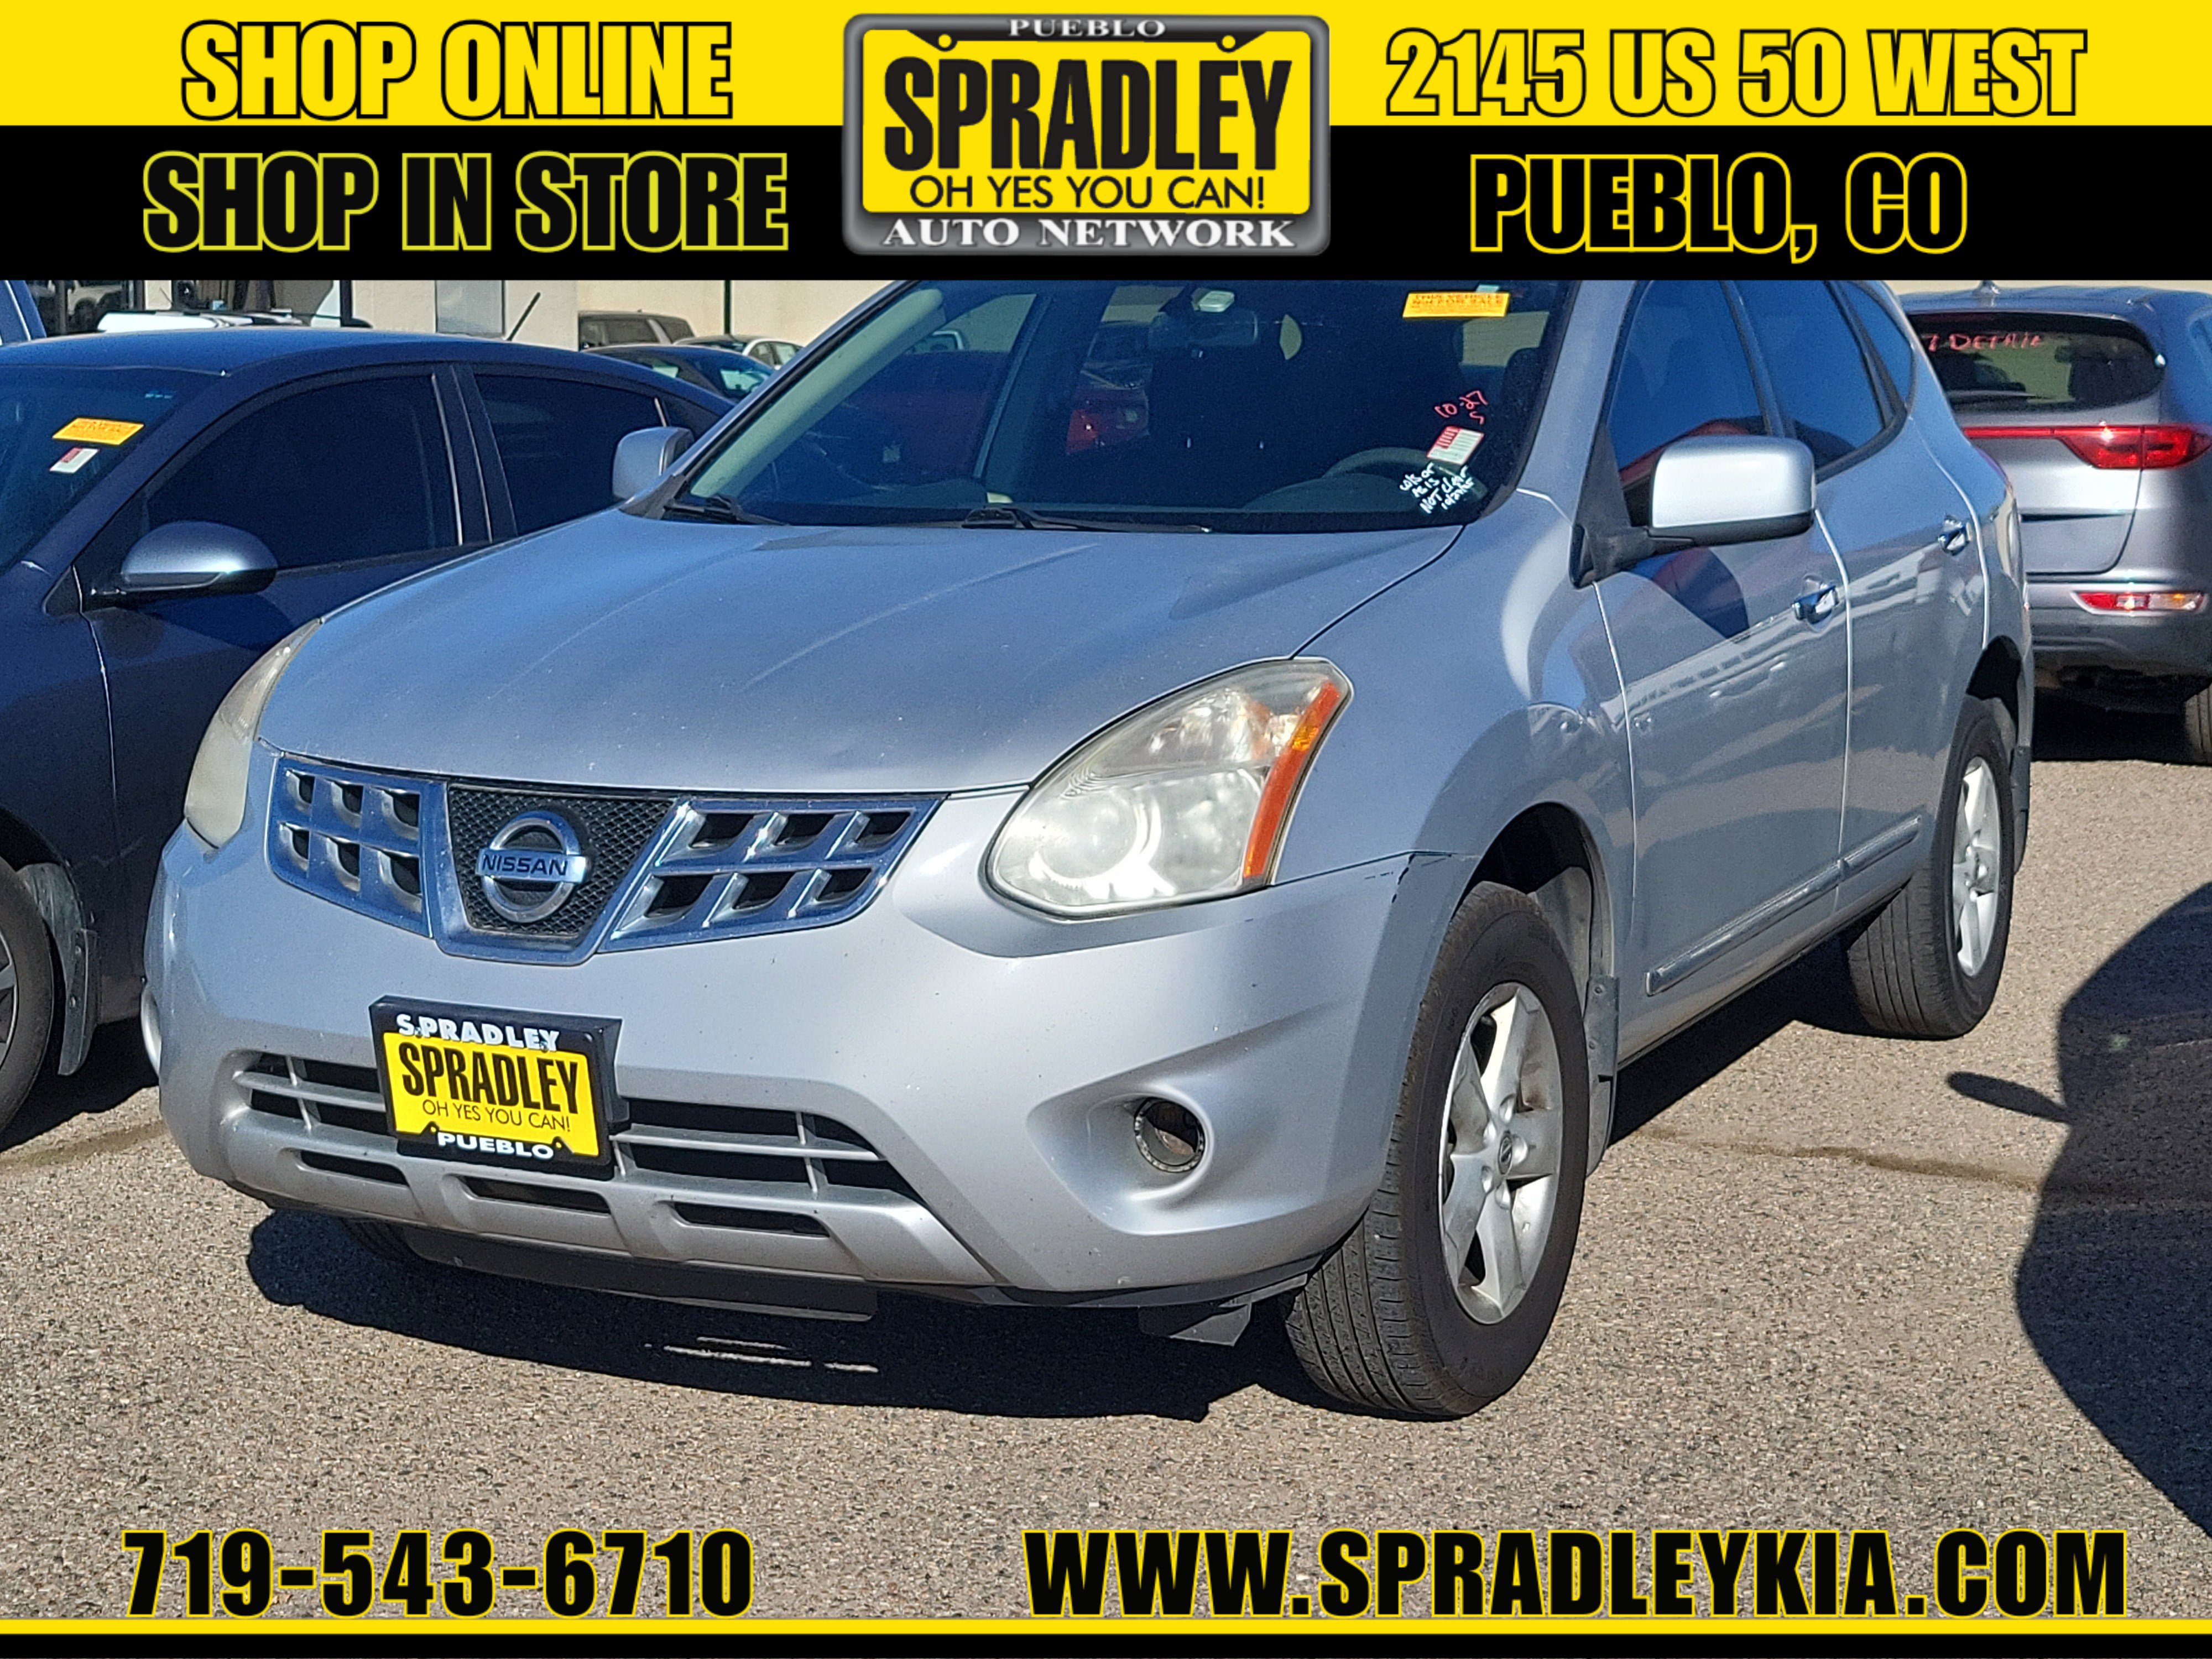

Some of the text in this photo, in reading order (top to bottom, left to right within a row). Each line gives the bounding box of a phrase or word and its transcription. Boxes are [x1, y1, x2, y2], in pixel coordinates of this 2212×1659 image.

[482, 854, 568, 876] NISSAN
[398, 1042, 578, 1114] SPRADLEY
[422, 1099, 570, 1133] OH YES YOU CAN!
[437, 1132, 554, 1160] PUEBLO
